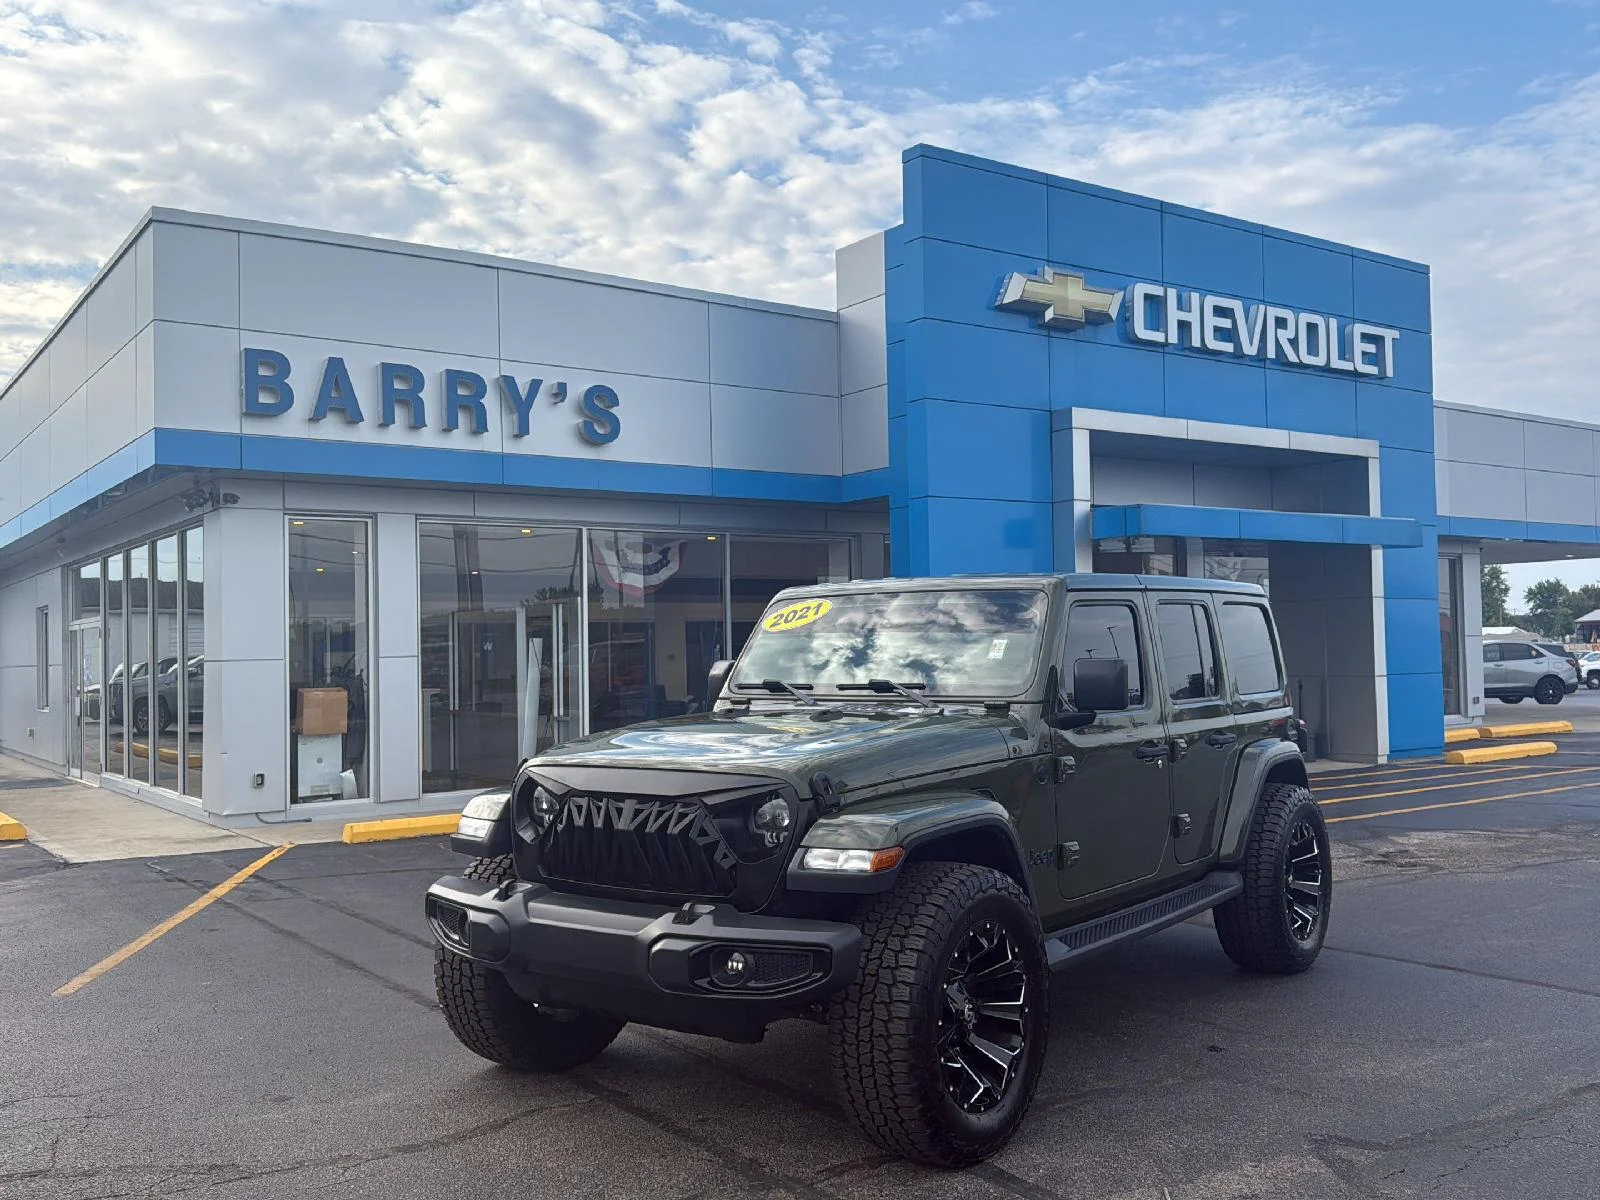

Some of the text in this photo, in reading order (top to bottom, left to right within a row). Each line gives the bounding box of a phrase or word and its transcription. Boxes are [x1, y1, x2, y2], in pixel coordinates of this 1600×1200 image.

[1127, 282, 1400, 378] CHEVROLET
[242, 347, 621, 446] BARRY'S
[768, 602, 824, 628] 2021
